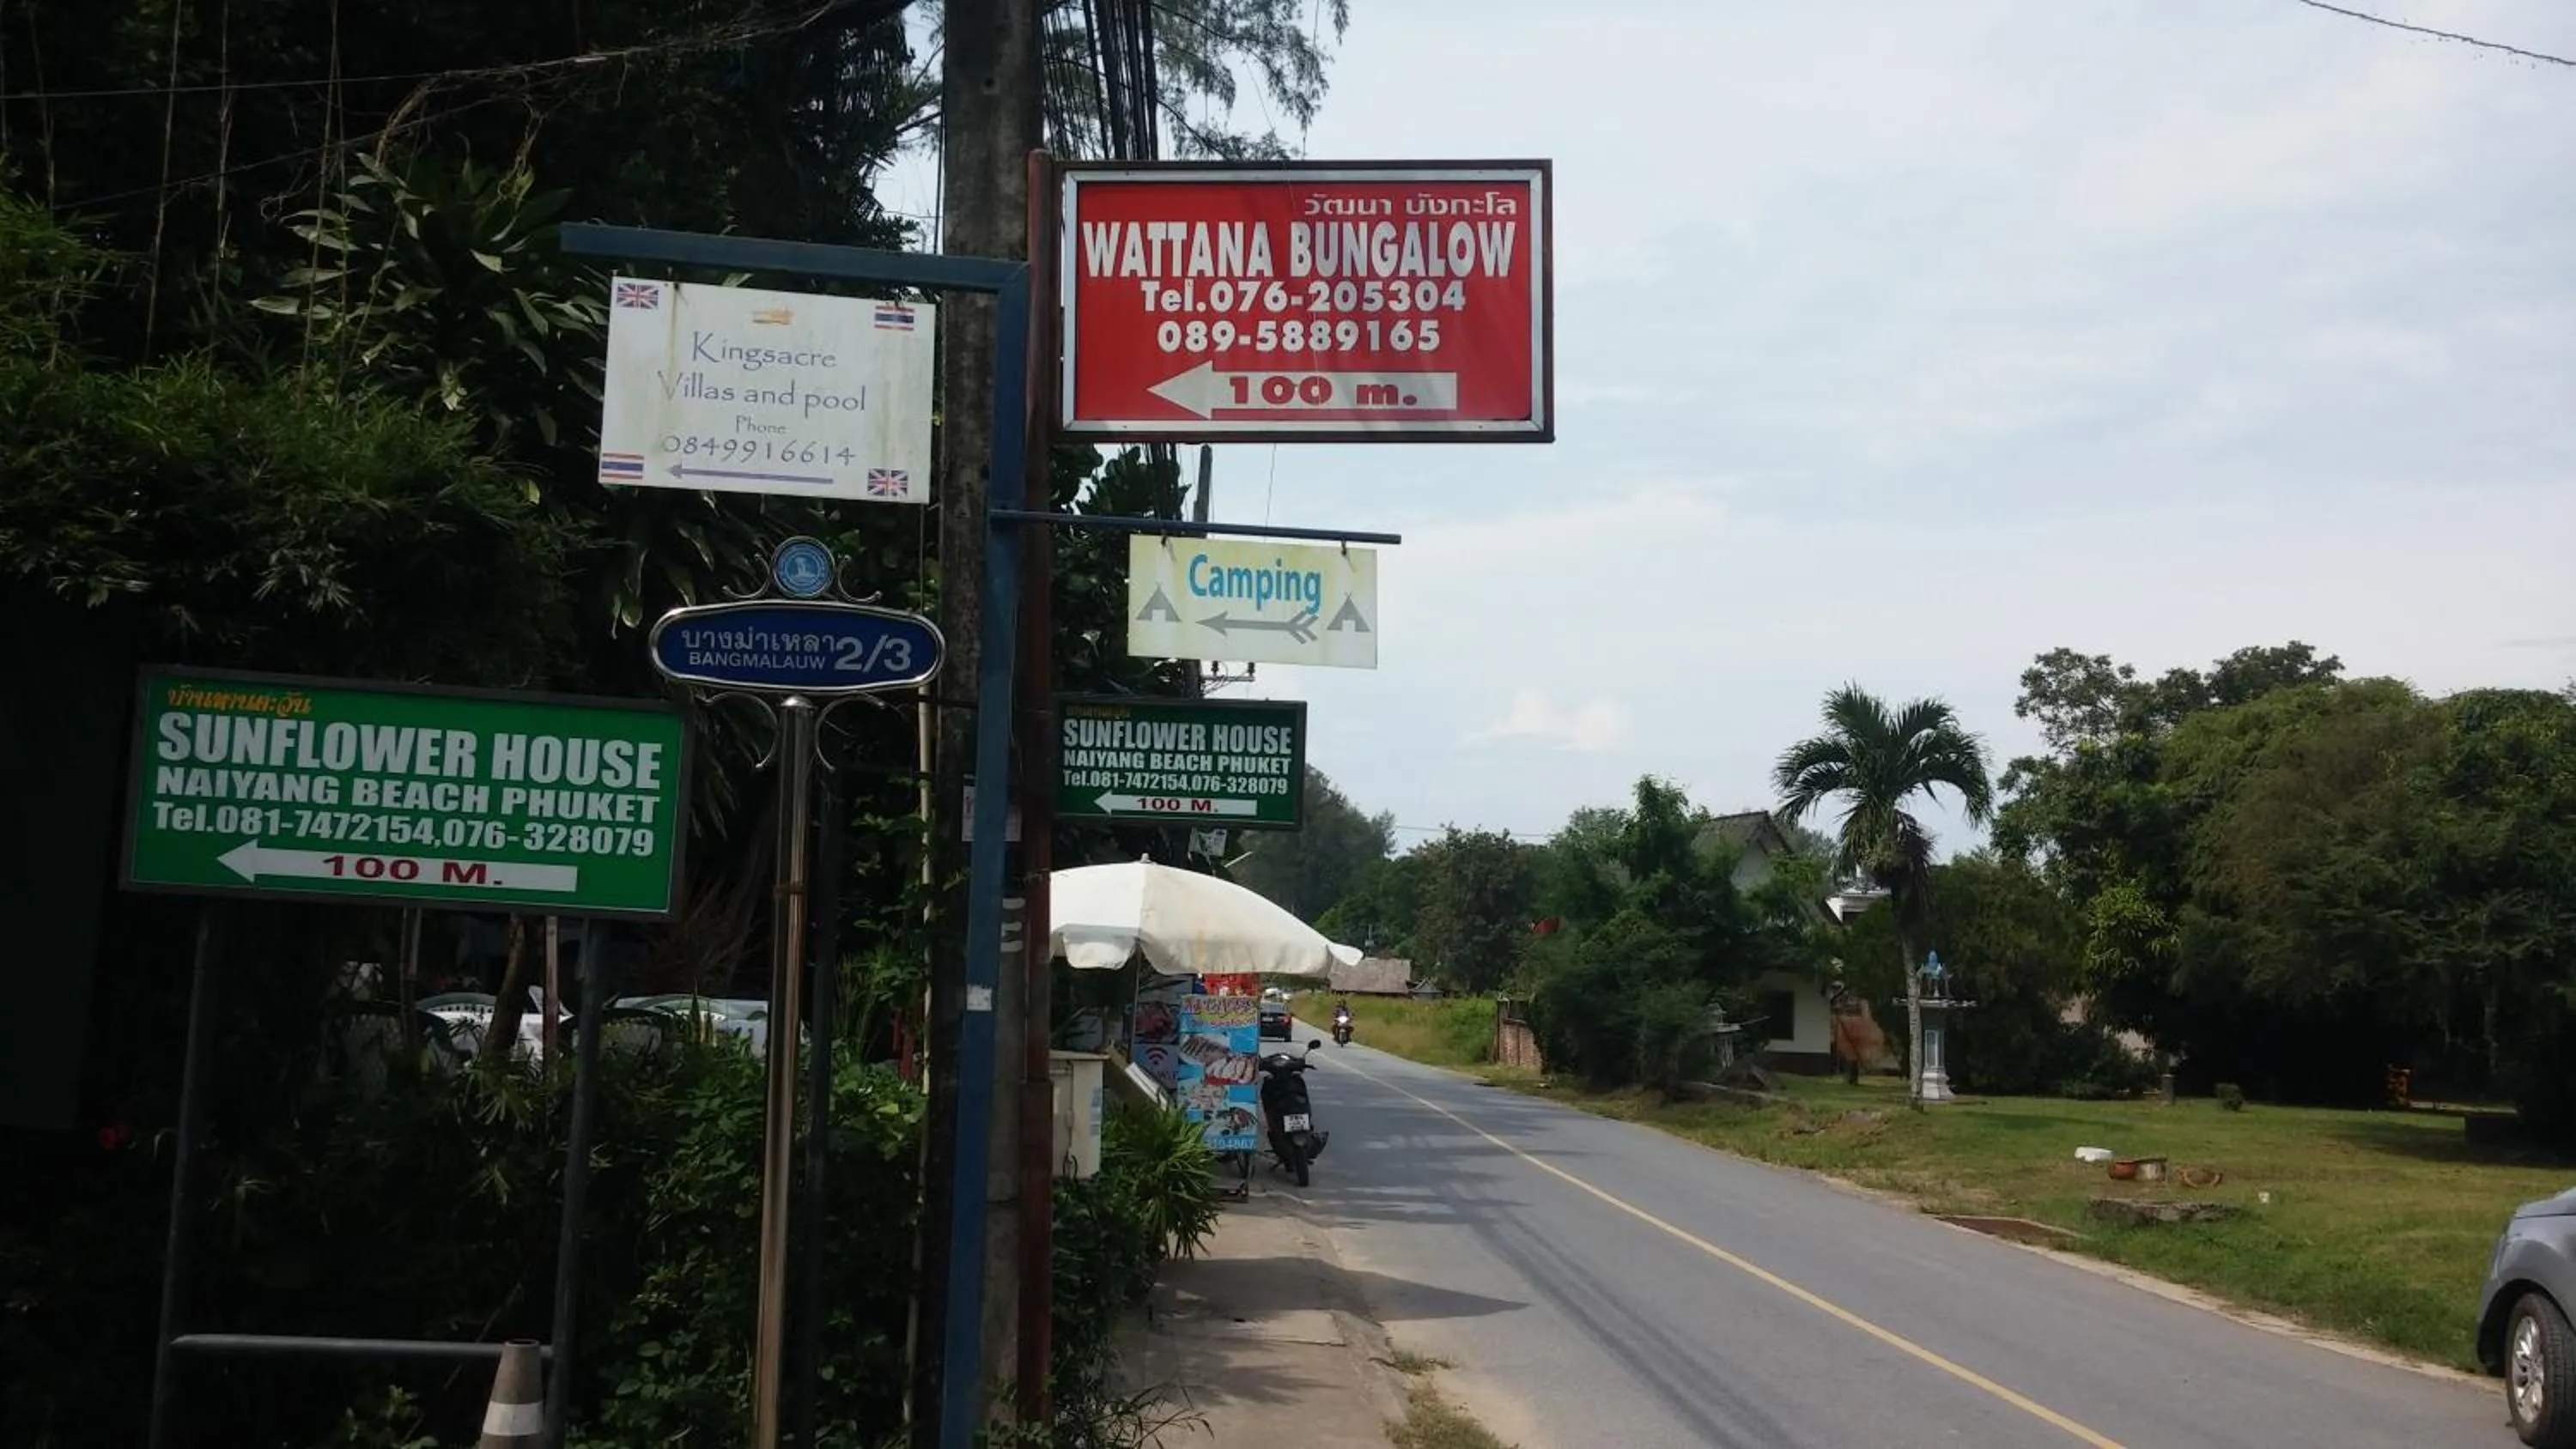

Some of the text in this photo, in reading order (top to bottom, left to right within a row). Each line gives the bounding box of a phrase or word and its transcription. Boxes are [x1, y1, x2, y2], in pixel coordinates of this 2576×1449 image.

[1304, 191, 1517, 216] วัฒนา บังกะโล
[1082, 221, 1516, 278] WATTANA BUNGALOW
[1140, 280, 1466, 313] Tel.076-205304
[691, 330, 837, 371] Kingsacre
[1157, 320, 1441, 353] 089-5889165
[657, 370, 866, 418] Villas and pool
[1229, 376, 1418, 406] 100 m.
[735, 415, 787, 435] Phone
[661, 434, 857, 466] 0849916614
[1188, 553, 1322, 615] Camping
[689, 652, 827, 670] BANGMALAUW
[834, 634, 912, 673] 2/3
[157, 712, 663, 790] SUNFLOWER HOUSE
[1063, 718, 1291, 755] SUNFLOWER HOUSE
[1064, 749, 1291, 774] NAIYANG BEACH PHUKET
[155, 767, 660, 824] NAIYANG BEACH PHUKET
[1137, 797, 1219, 813] 100 M.
[321, 853, 503, 886] 100 M.
